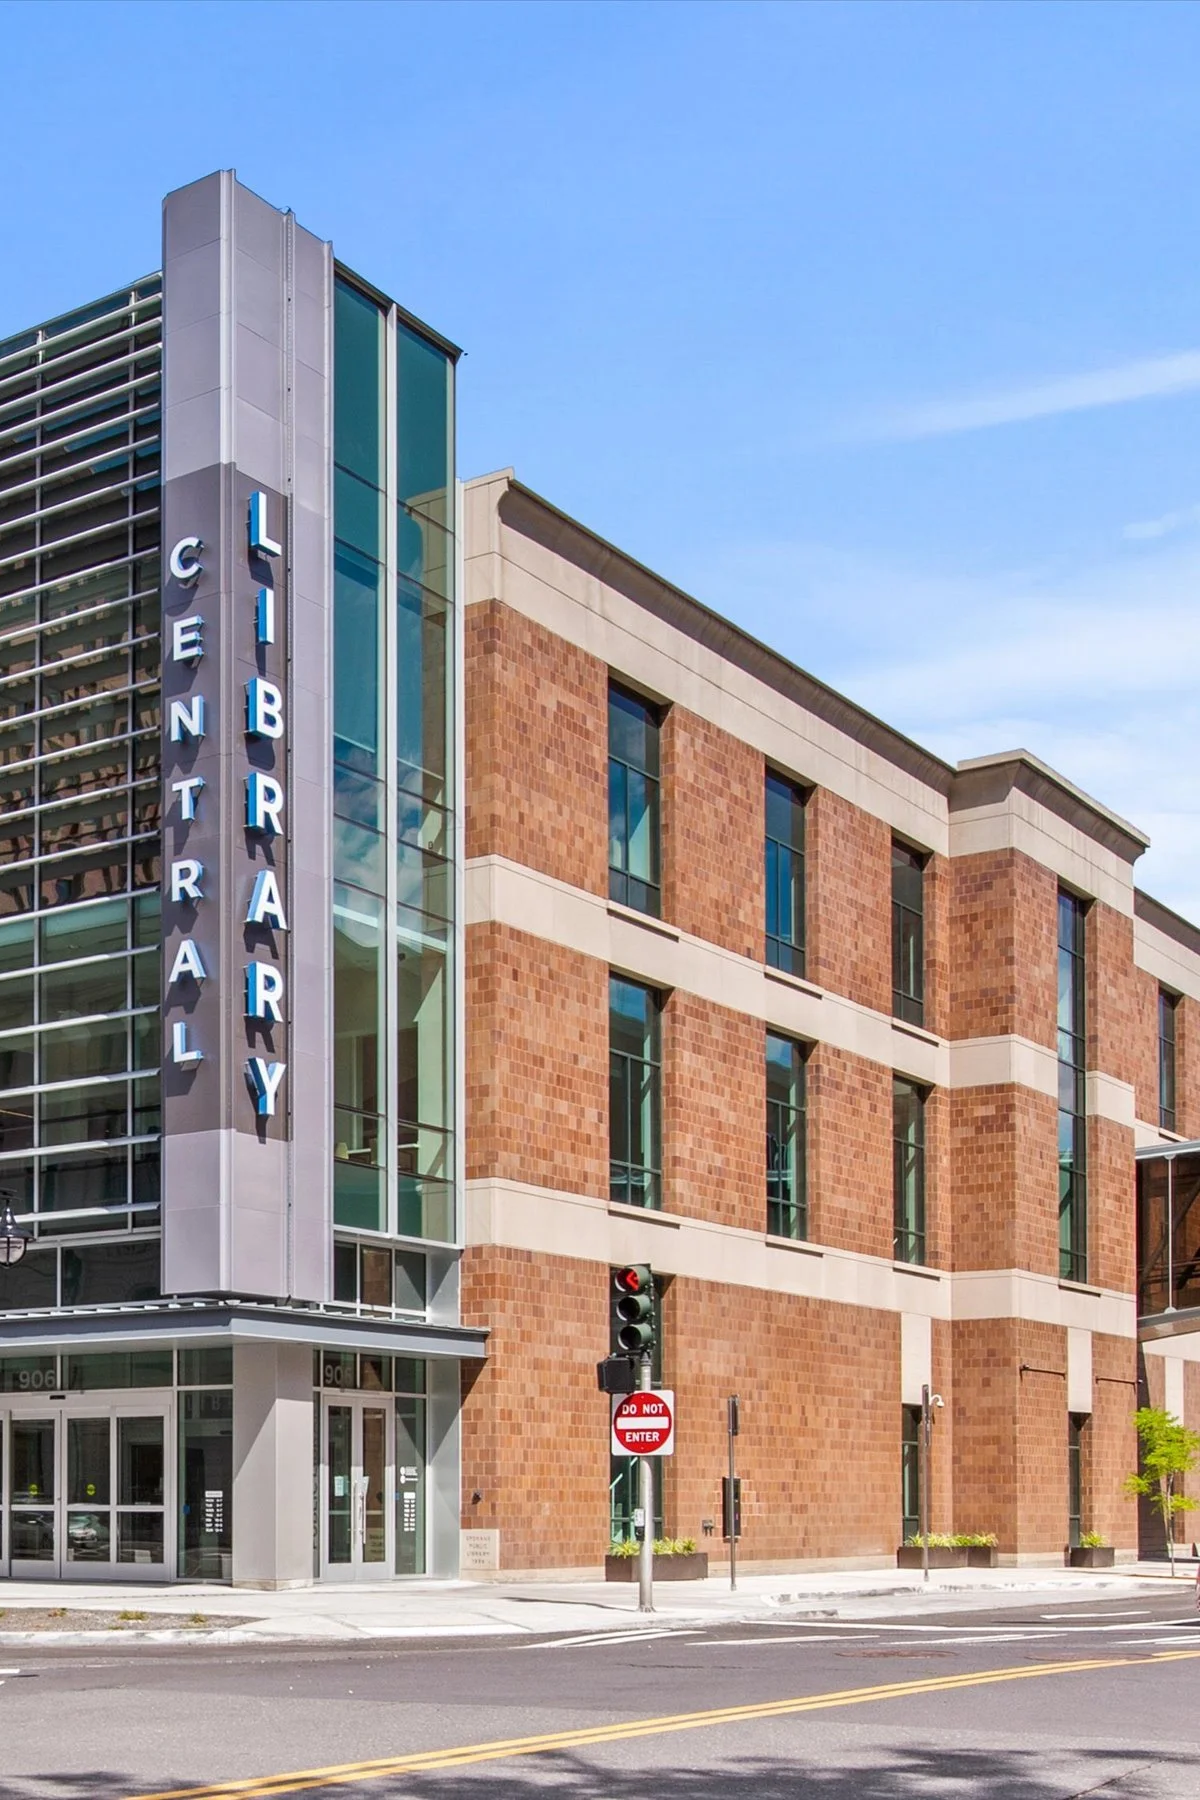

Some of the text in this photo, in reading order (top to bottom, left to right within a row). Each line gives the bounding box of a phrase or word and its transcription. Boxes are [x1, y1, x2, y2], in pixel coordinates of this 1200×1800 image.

[168, 536, 206, 1067] CENTRAL
[247, 490, 288, 1116] LIBRARY
[19, 1370, 55, 1389] 906
[622, 1403, 664, 1415] DO NOT
[625, 1431, 660, 1442] ENTER
